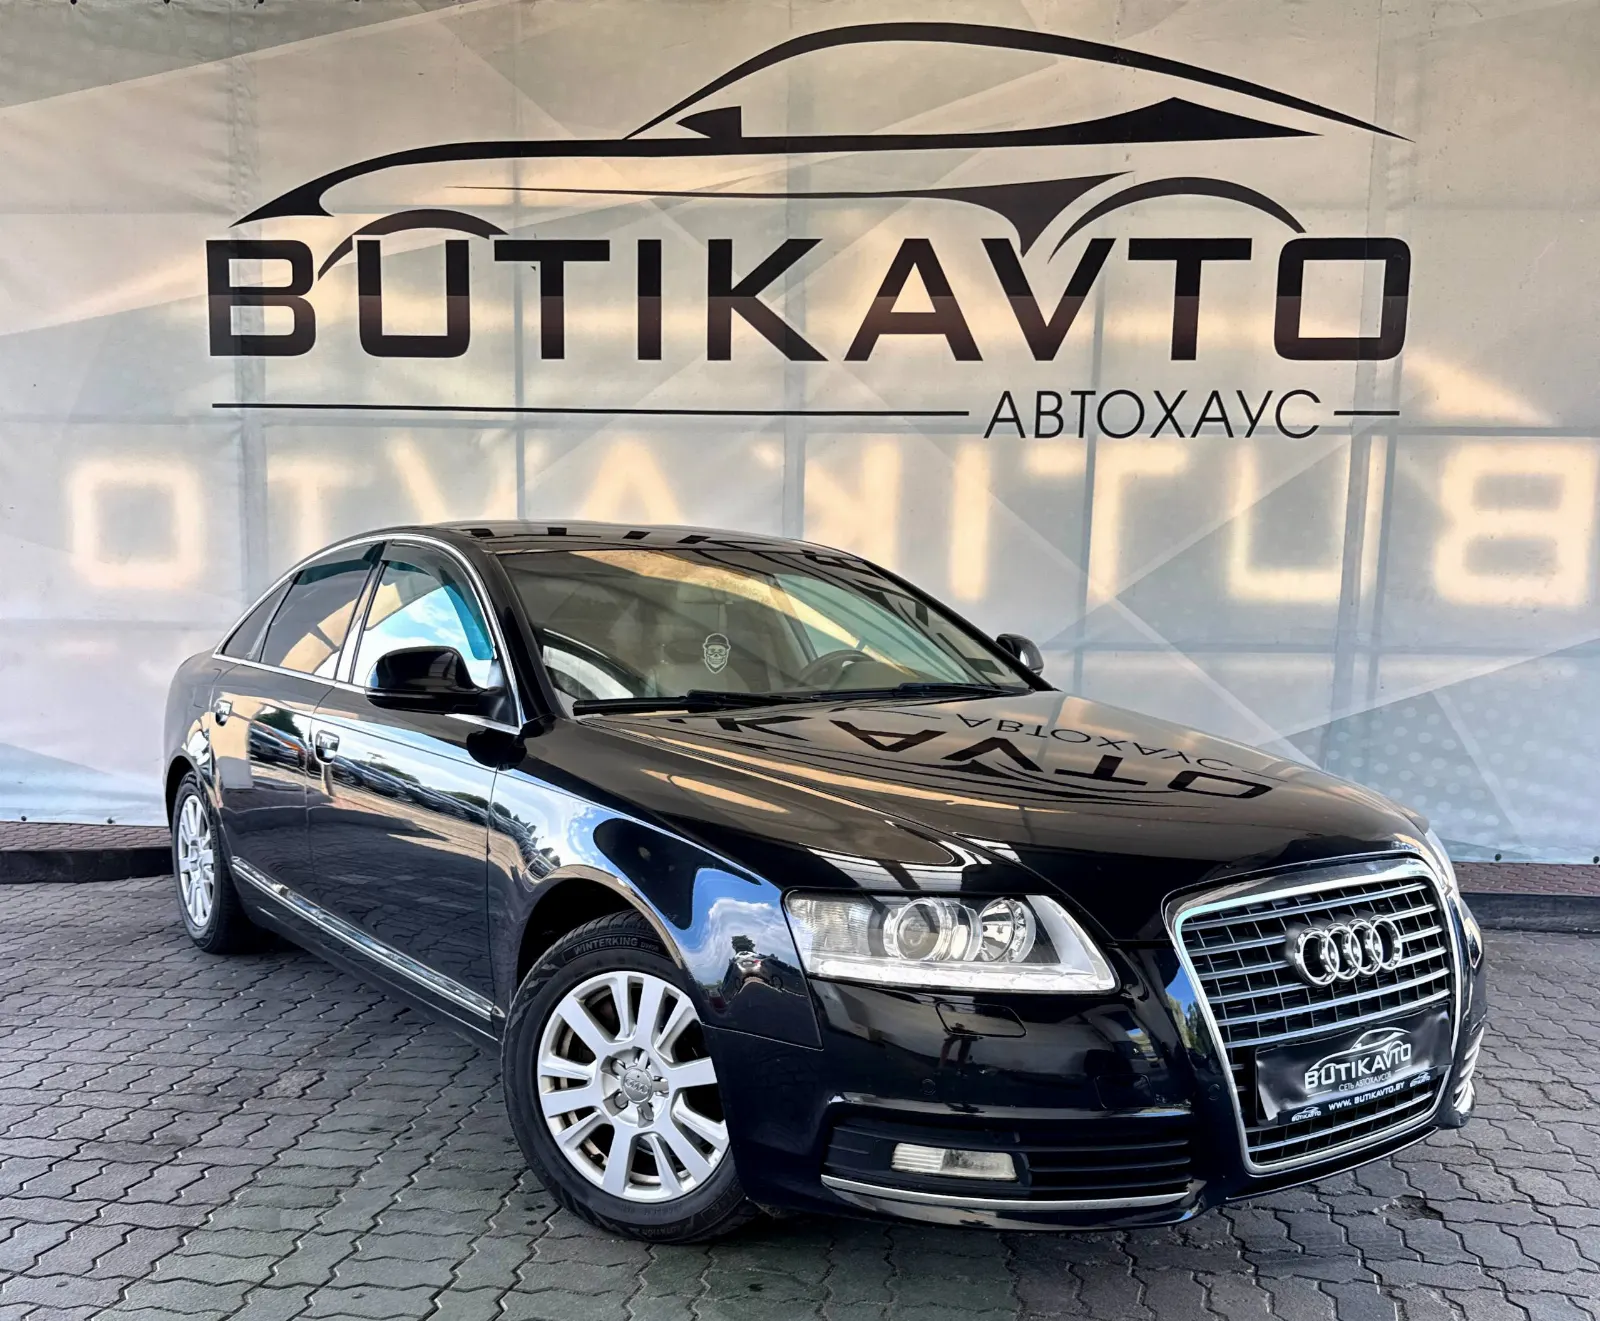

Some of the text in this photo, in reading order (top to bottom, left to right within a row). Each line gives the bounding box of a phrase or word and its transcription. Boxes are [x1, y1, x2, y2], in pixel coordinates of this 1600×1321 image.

[206, 238, 1411, 362] BUTIKAVTO
[984, 389, 1321, 439] АВТОХАУС
[573, 936, 639, 955] WINTERKING
[1304, 1043, 1412, 1090] BUTIKAVTO
[1328, 1098, 1352, 1111] WWW.
[1354, 1081, 1405, 1104] BUTIKAVTO.BY
